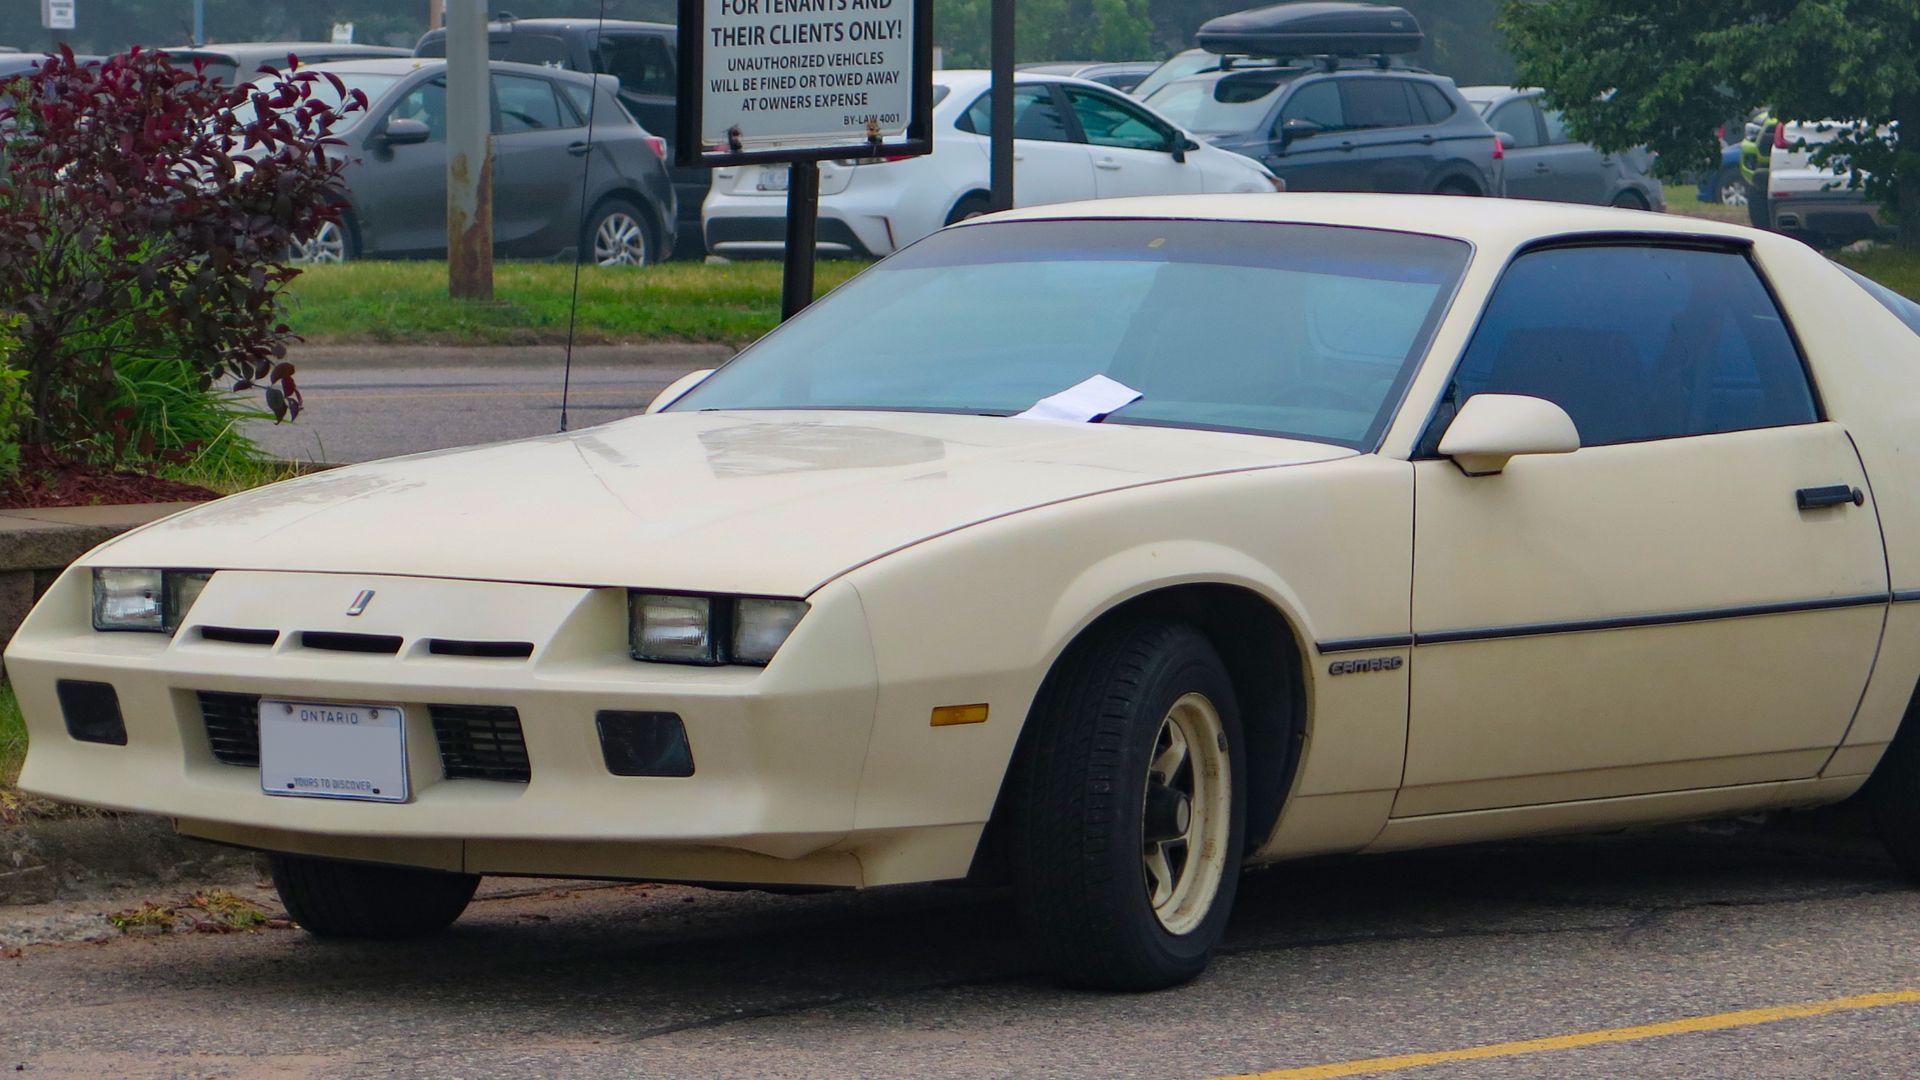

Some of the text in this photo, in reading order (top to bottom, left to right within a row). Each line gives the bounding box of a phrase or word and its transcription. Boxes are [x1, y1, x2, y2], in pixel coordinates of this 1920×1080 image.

[721, 0, 759, 15] FOR
[764, 0, 847, 14] TENANTS
[711, 19, 902, 47] THEIR CLIENTS ONLY!
[727, 51, 884, 71] UNAUTHORIZED VEHICLES
[711, 70, 900, 92] WILL BE FINED OR TOWED AWAY
[742, 92, 868, 111] AT OWNERS EXPENSE
[843, 113, 900, 125] BY-LAW 4001
[1328, 656, 1403, 675] CAMARO
[301, 709, 358, 724] ONTARIO
[294, 777, 372, 791] YOURS TO DISCOVER
